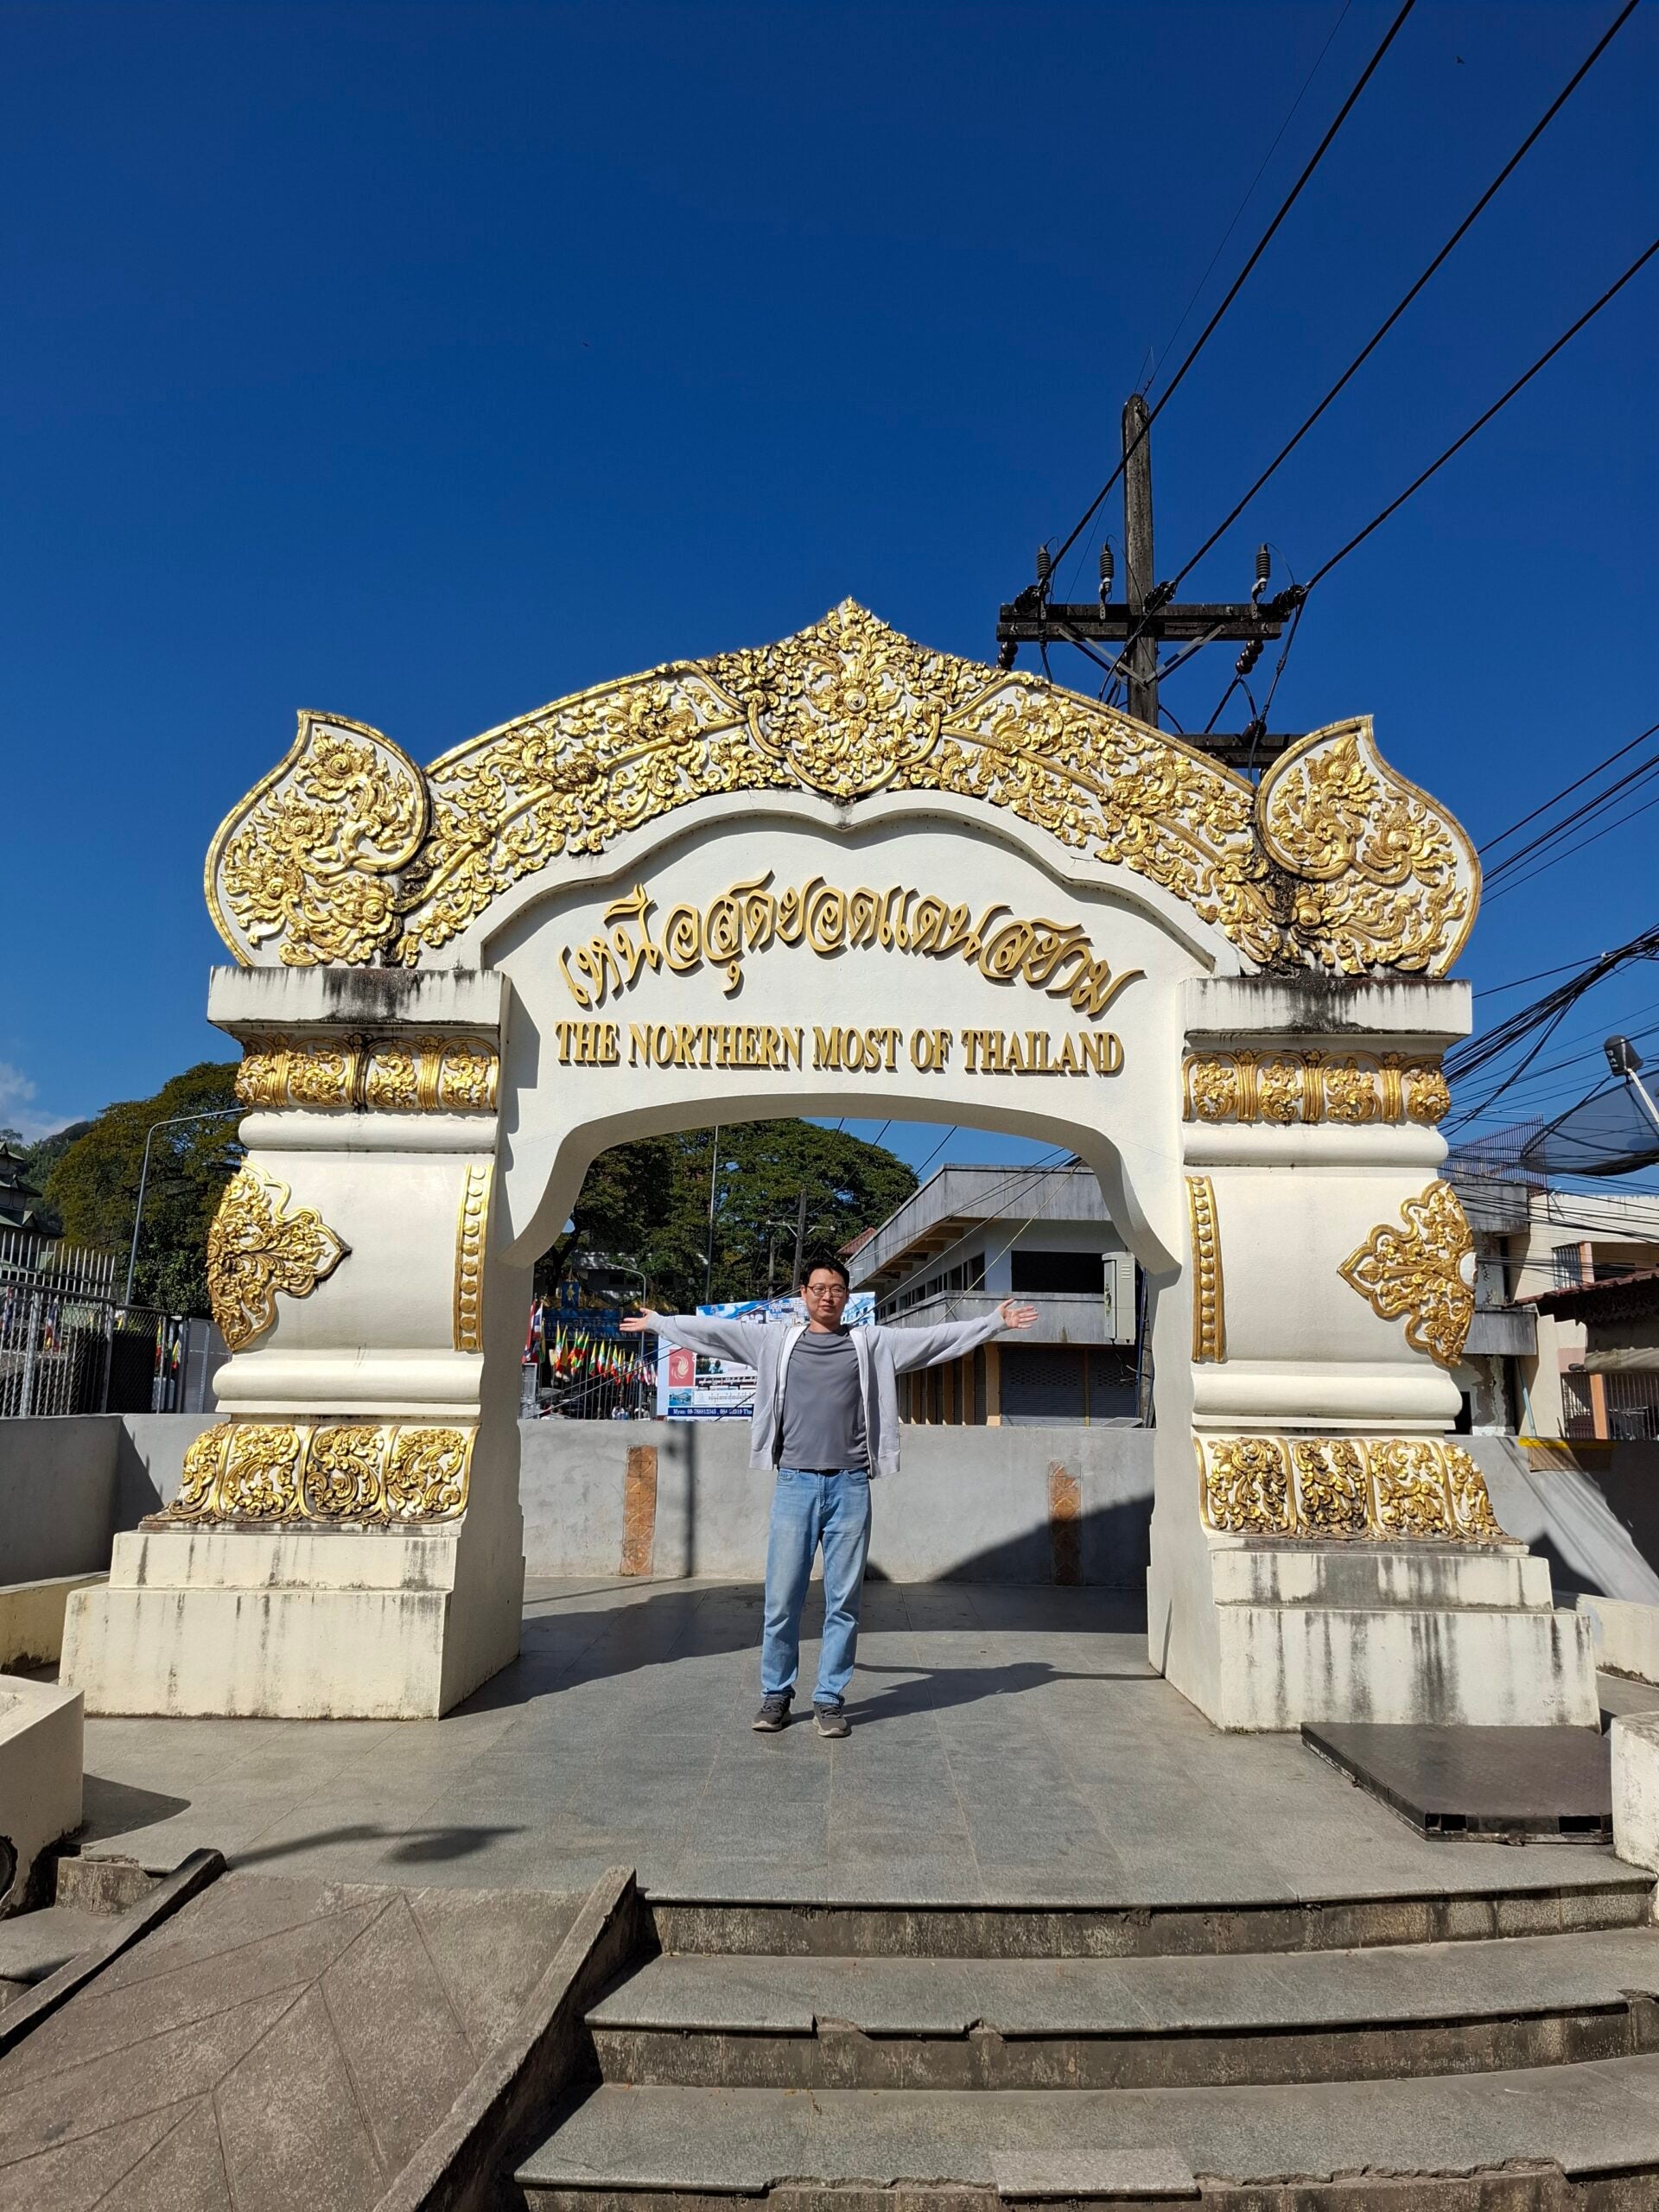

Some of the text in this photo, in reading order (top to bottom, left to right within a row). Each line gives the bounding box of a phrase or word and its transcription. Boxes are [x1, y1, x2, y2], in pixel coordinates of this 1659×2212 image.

[558, 869, 1146, 1014] เหนือสุดยอดแดนสยาม
[555, 1021, 1124, 1073] THE NORTHERN MOST OF THAILAND
[1606, 1050, 1618, 1067] PSI
